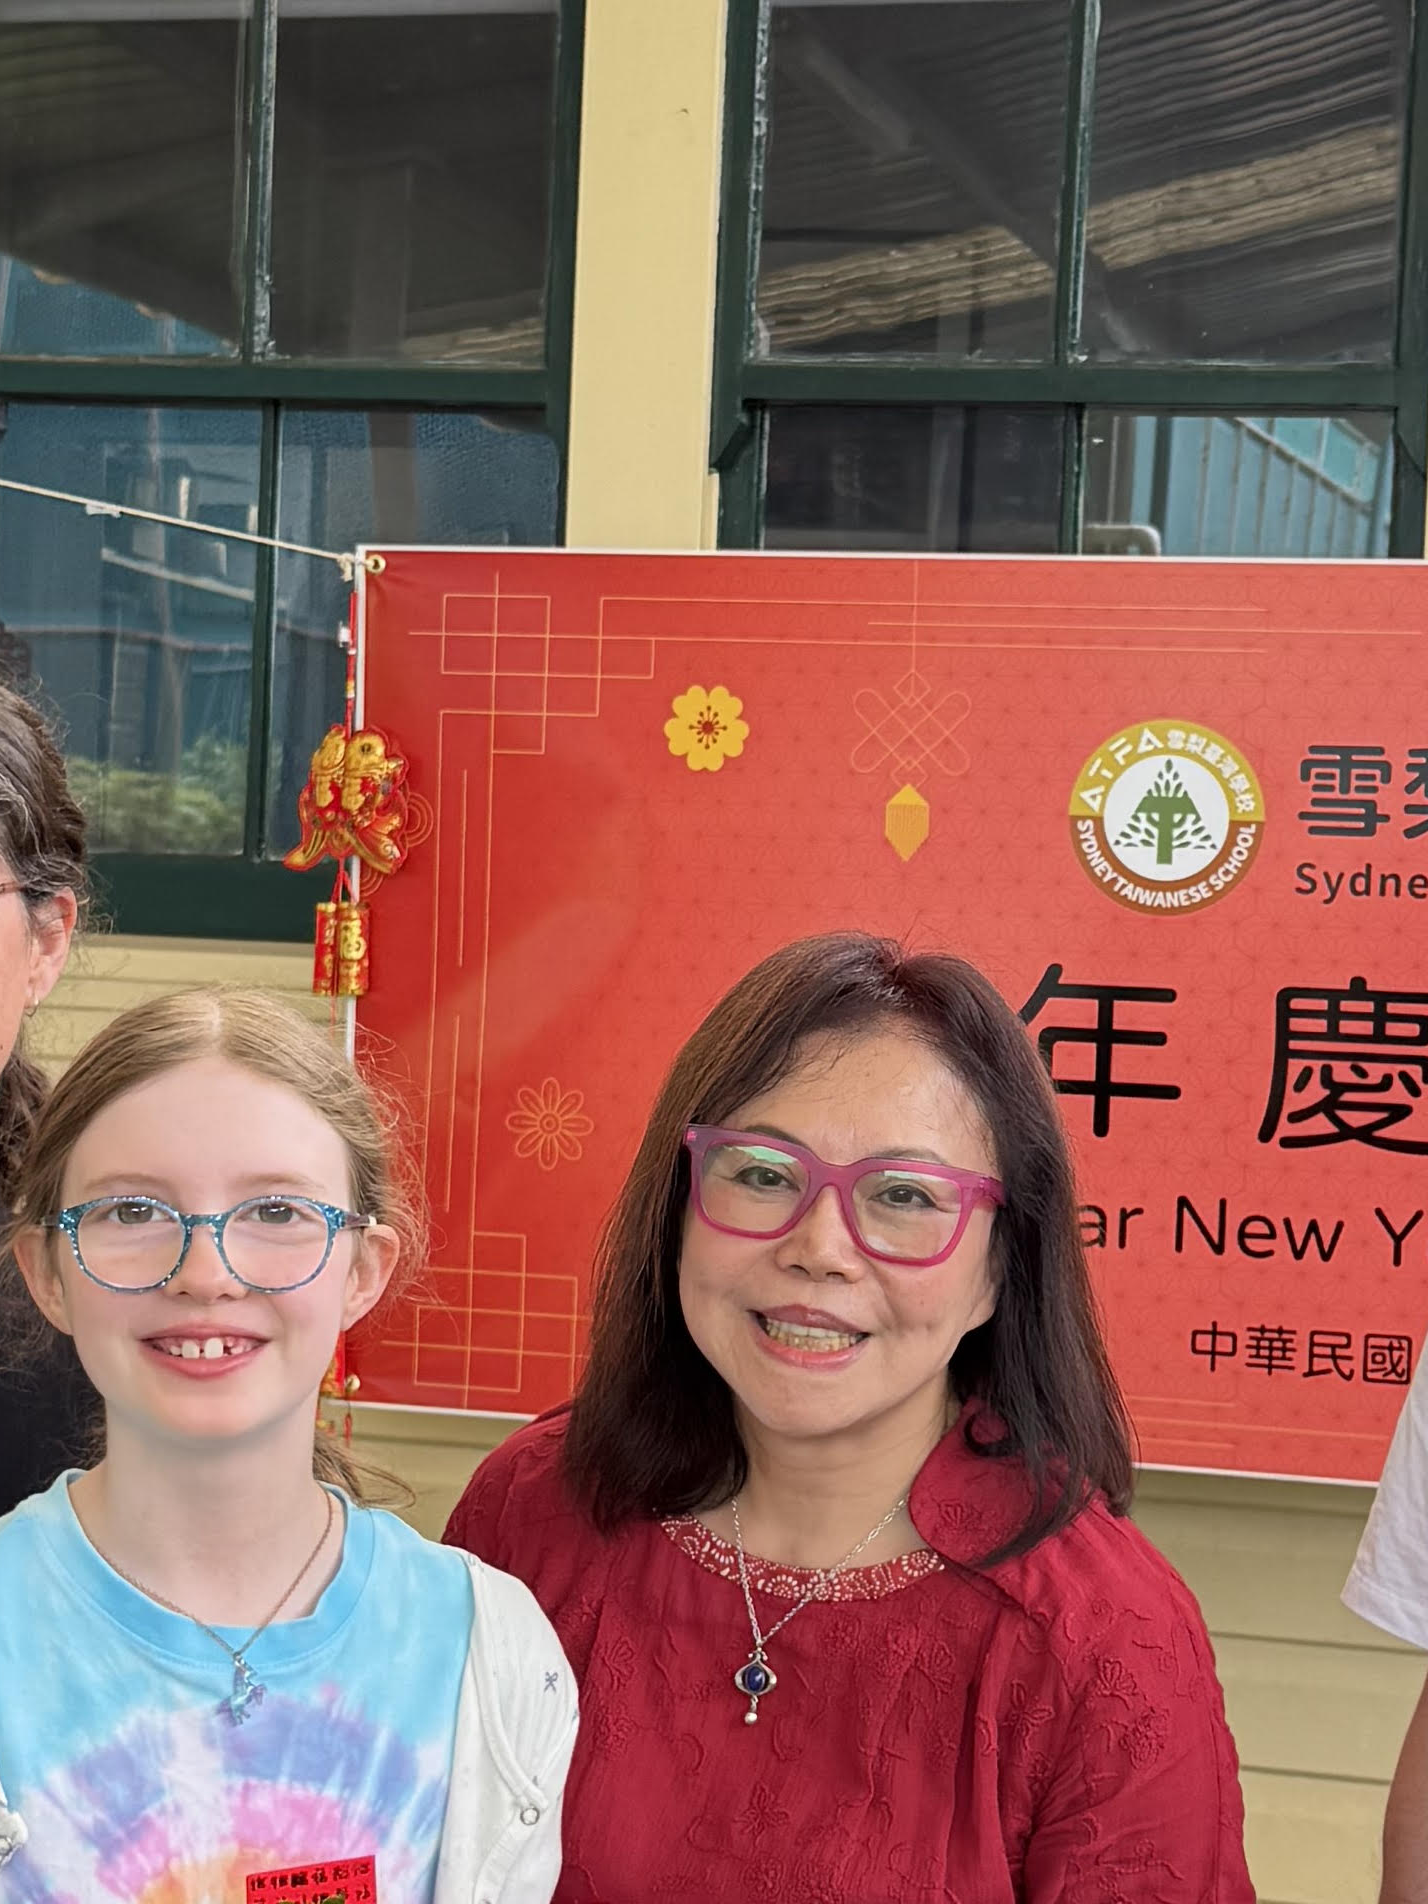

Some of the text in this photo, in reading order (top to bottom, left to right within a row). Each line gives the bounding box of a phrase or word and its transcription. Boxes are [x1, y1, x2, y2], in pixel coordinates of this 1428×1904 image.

[1076, 819, 1257, 909] SYDNEY TAIWANESE SCHOOL
[1174, 1195, 1345, 1263] New
[1190, 1320, 1413, 1386] 中華民國
